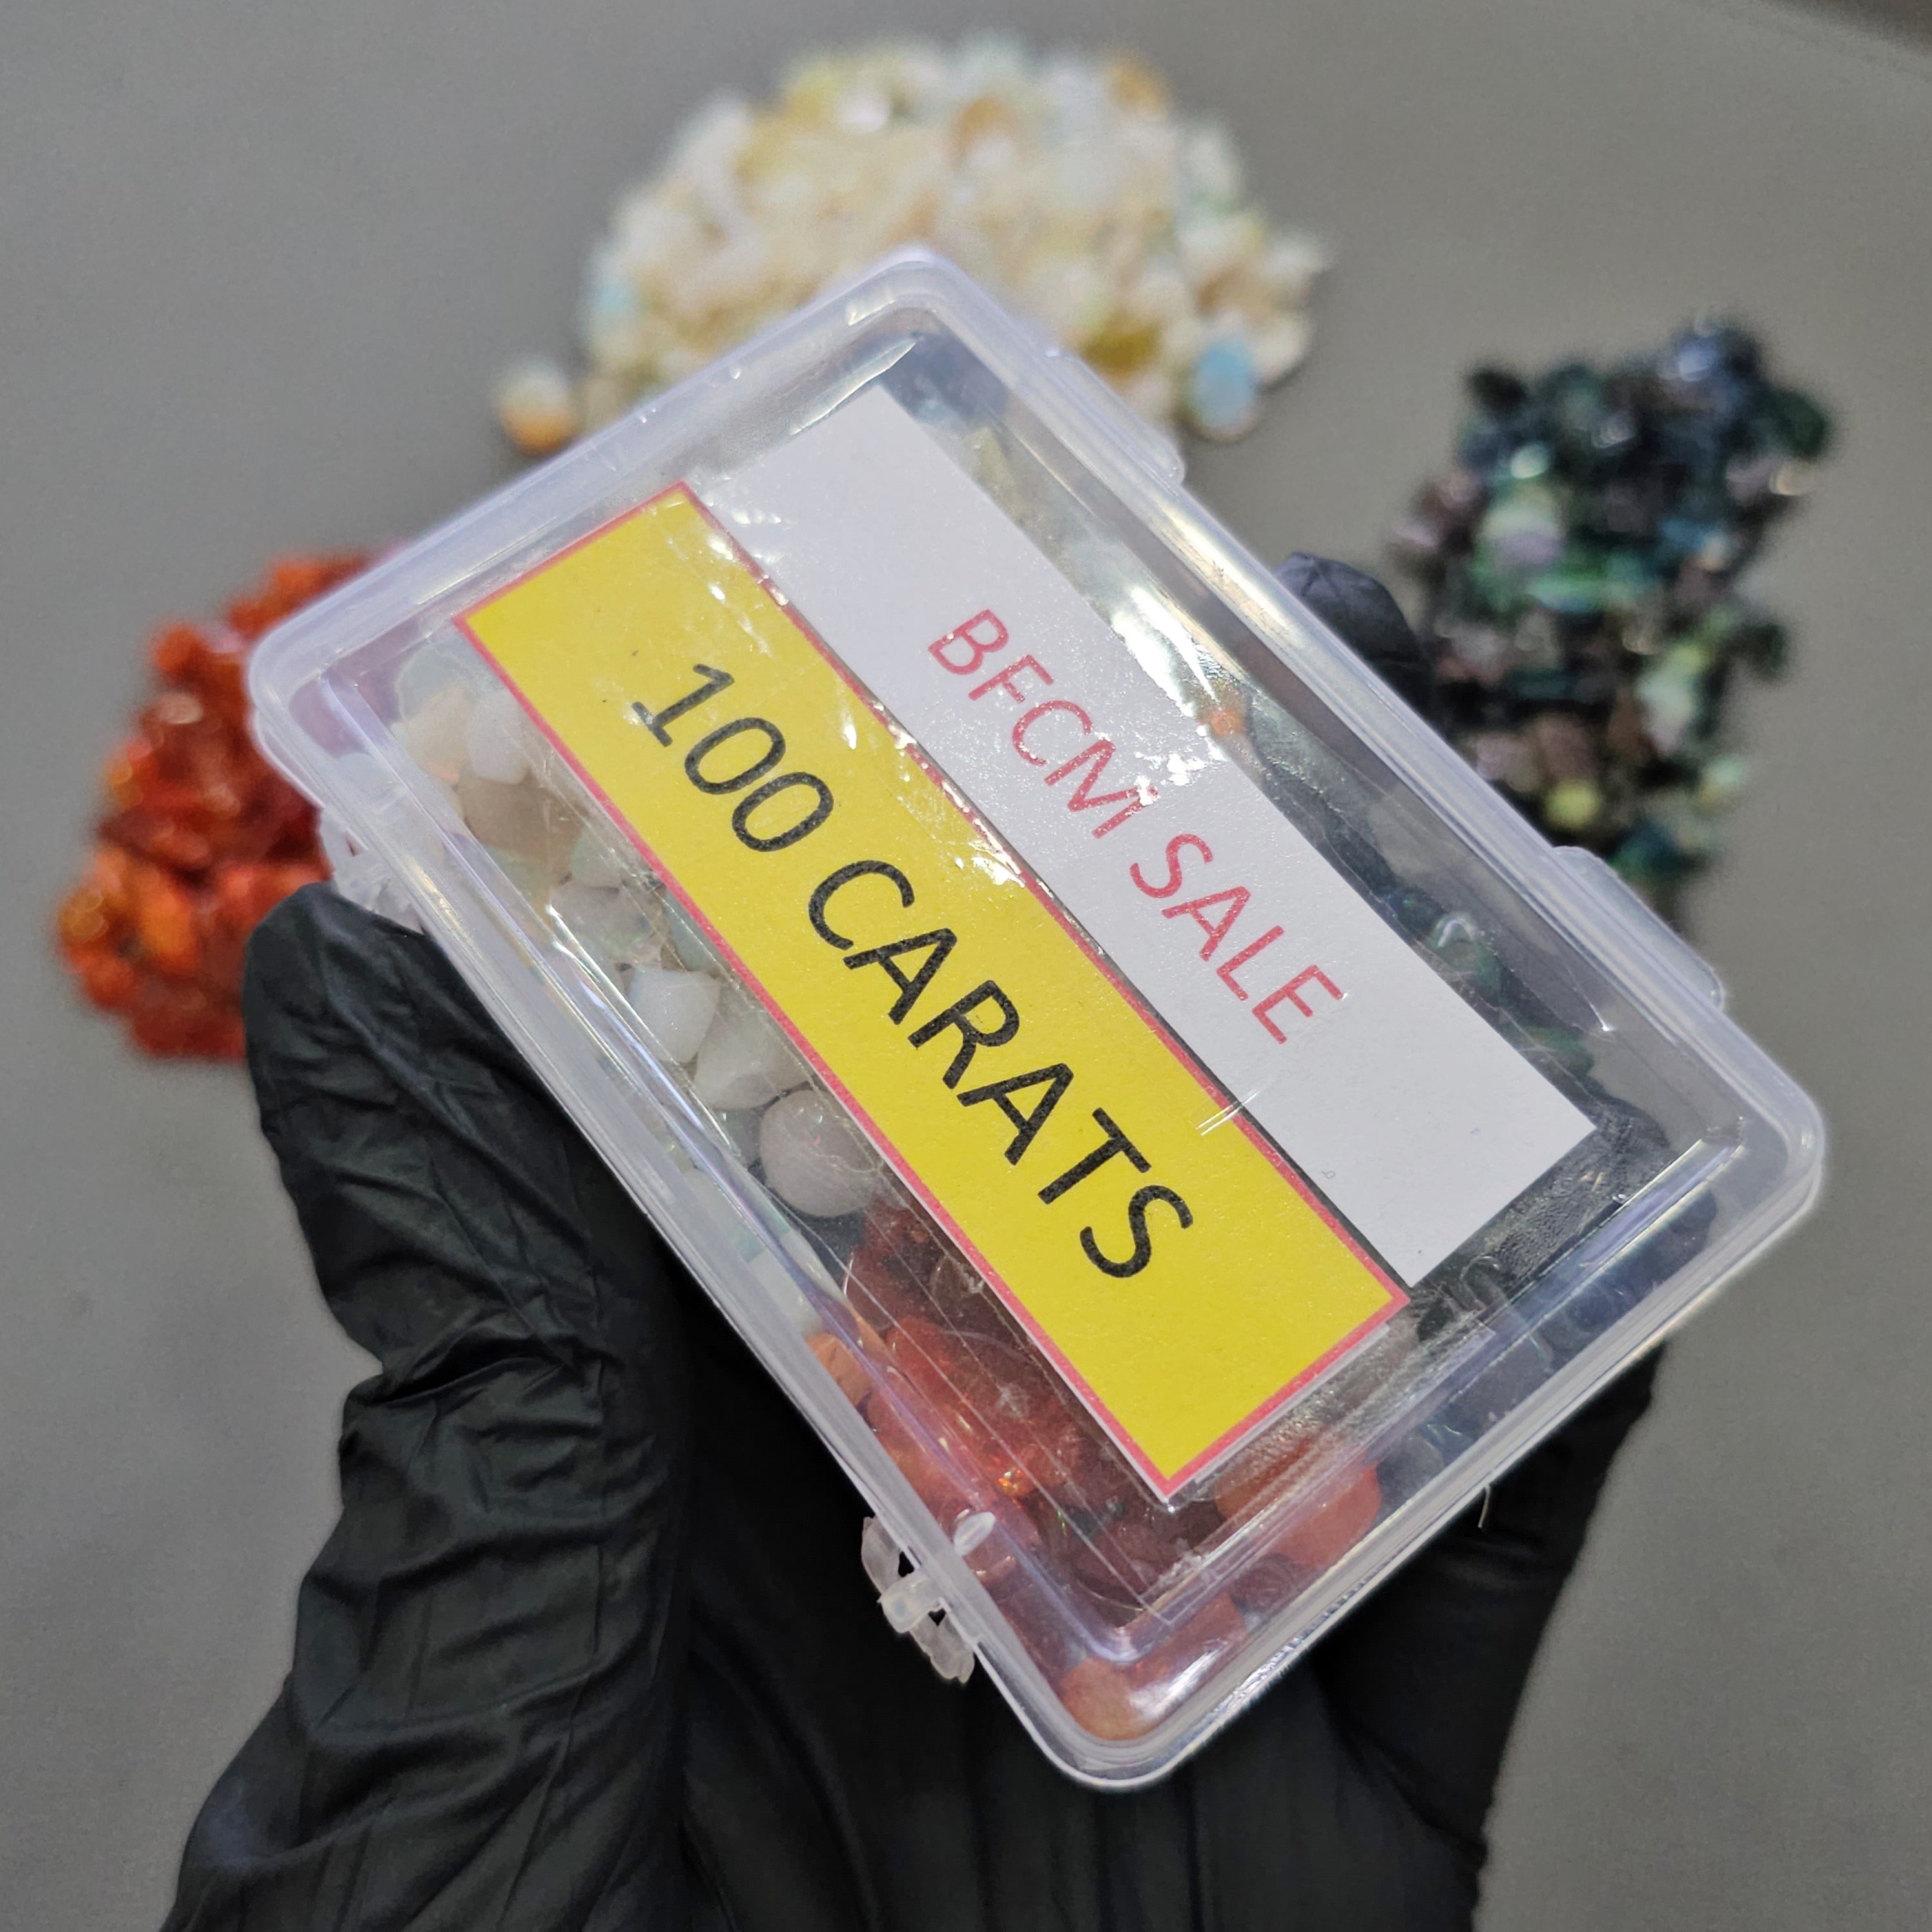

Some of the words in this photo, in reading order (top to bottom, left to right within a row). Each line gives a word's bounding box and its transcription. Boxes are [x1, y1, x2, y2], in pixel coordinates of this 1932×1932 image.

[632, 663, 834, 852] 100
[808, 859, 1193, 1278] CARATS
[928, 609, 1159, 839] BFCM
[1129, 834, 1344, 1044] SALE
